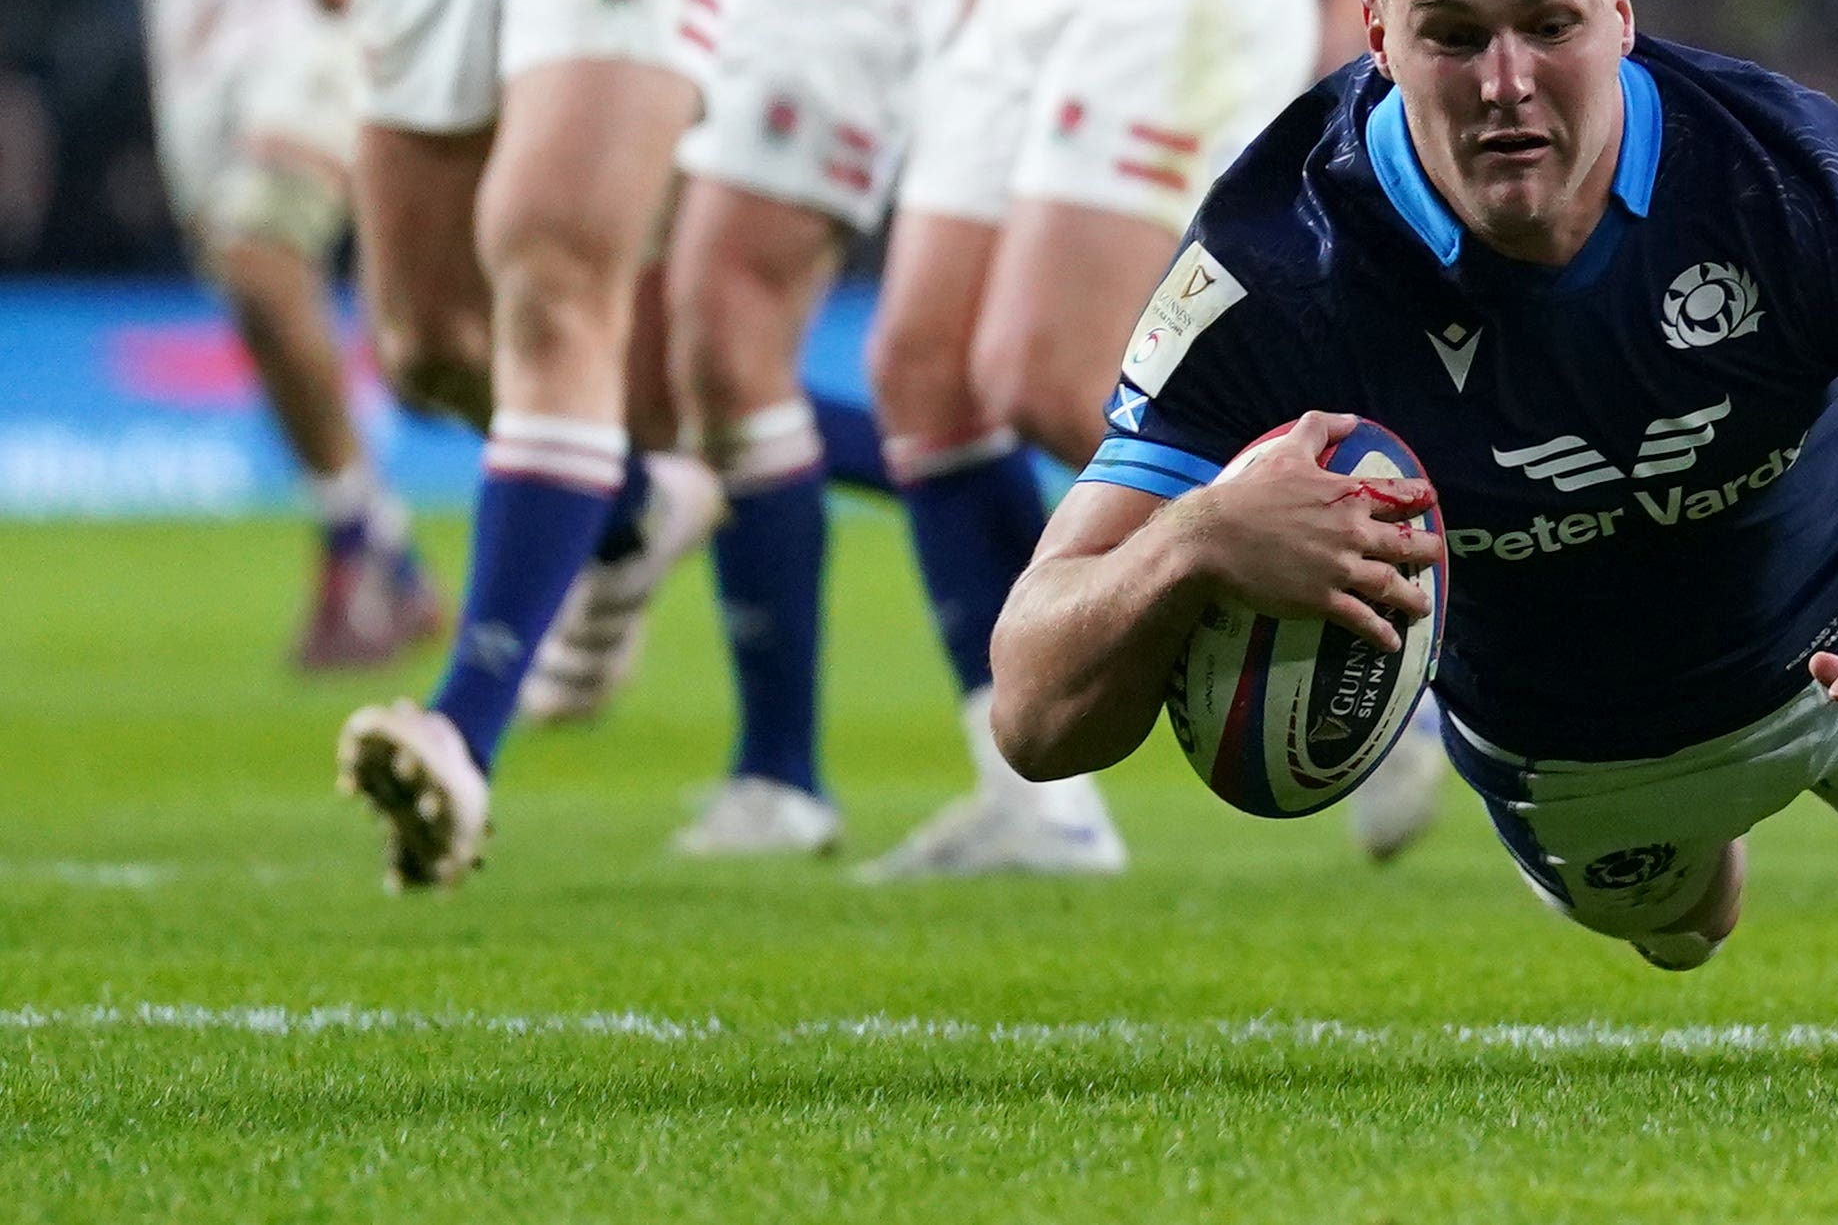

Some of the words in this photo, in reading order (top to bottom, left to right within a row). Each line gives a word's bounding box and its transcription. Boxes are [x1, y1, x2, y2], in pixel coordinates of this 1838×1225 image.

[1446, 506, 1625, 561] Peter
[1632, 428, 1809, 527] Vardy
[1357, 688, 1379, 718] SIX
